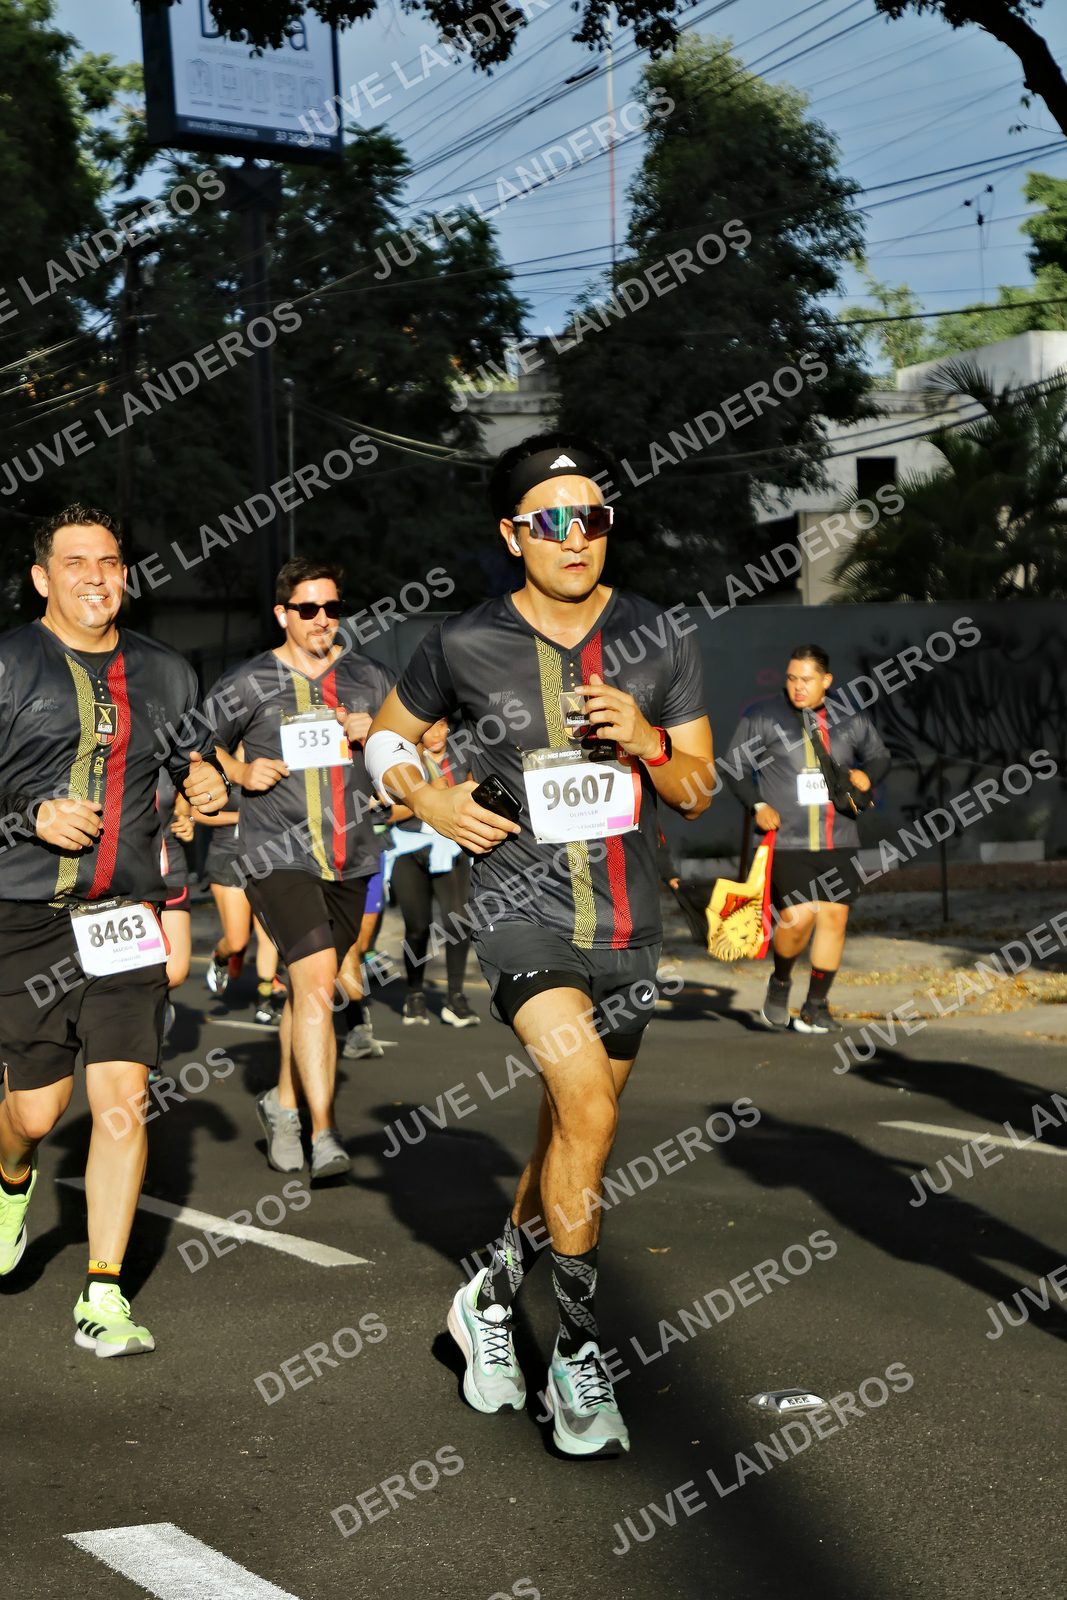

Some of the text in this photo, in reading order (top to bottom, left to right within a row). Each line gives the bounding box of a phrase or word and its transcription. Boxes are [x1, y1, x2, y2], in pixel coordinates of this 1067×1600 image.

[298, 728, 330, 748] 535
[542, 772, 615, 810] 9607
[88, 914, 146, 948] 8463
